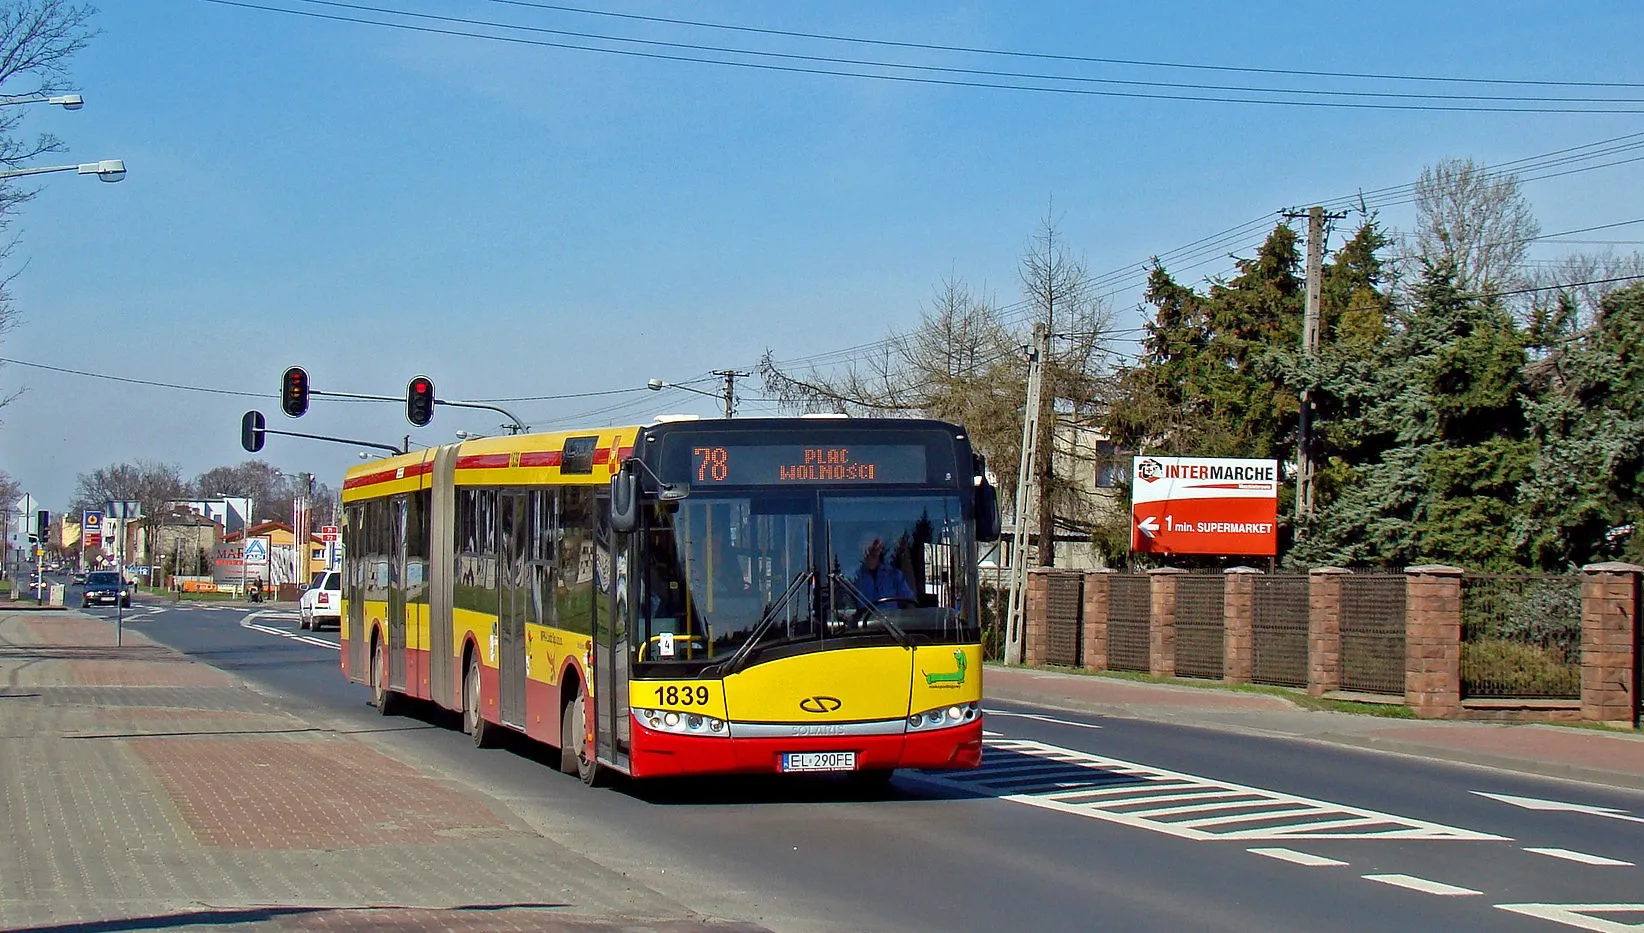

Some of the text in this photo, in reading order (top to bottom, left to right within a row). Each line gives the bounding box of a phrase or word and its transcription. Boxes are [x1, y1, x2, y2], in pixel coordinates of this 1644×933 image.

[694, 447, 728, 481] 78
[804, 449, 849, 464] PLAC
[779, 463, 876, 481] WOLNOŚCI
[1165, 464, 1274, 481] INTERMARCHE
[1164, 514, 1273, 534] 1 min. SUPERMARKET
[664, 640, 670, 649] 4
[655, 685, 709, 706] 1839
[792, 725, 846, 737] SOLARIS
[790, 753, 853, 768] EL 290FE
